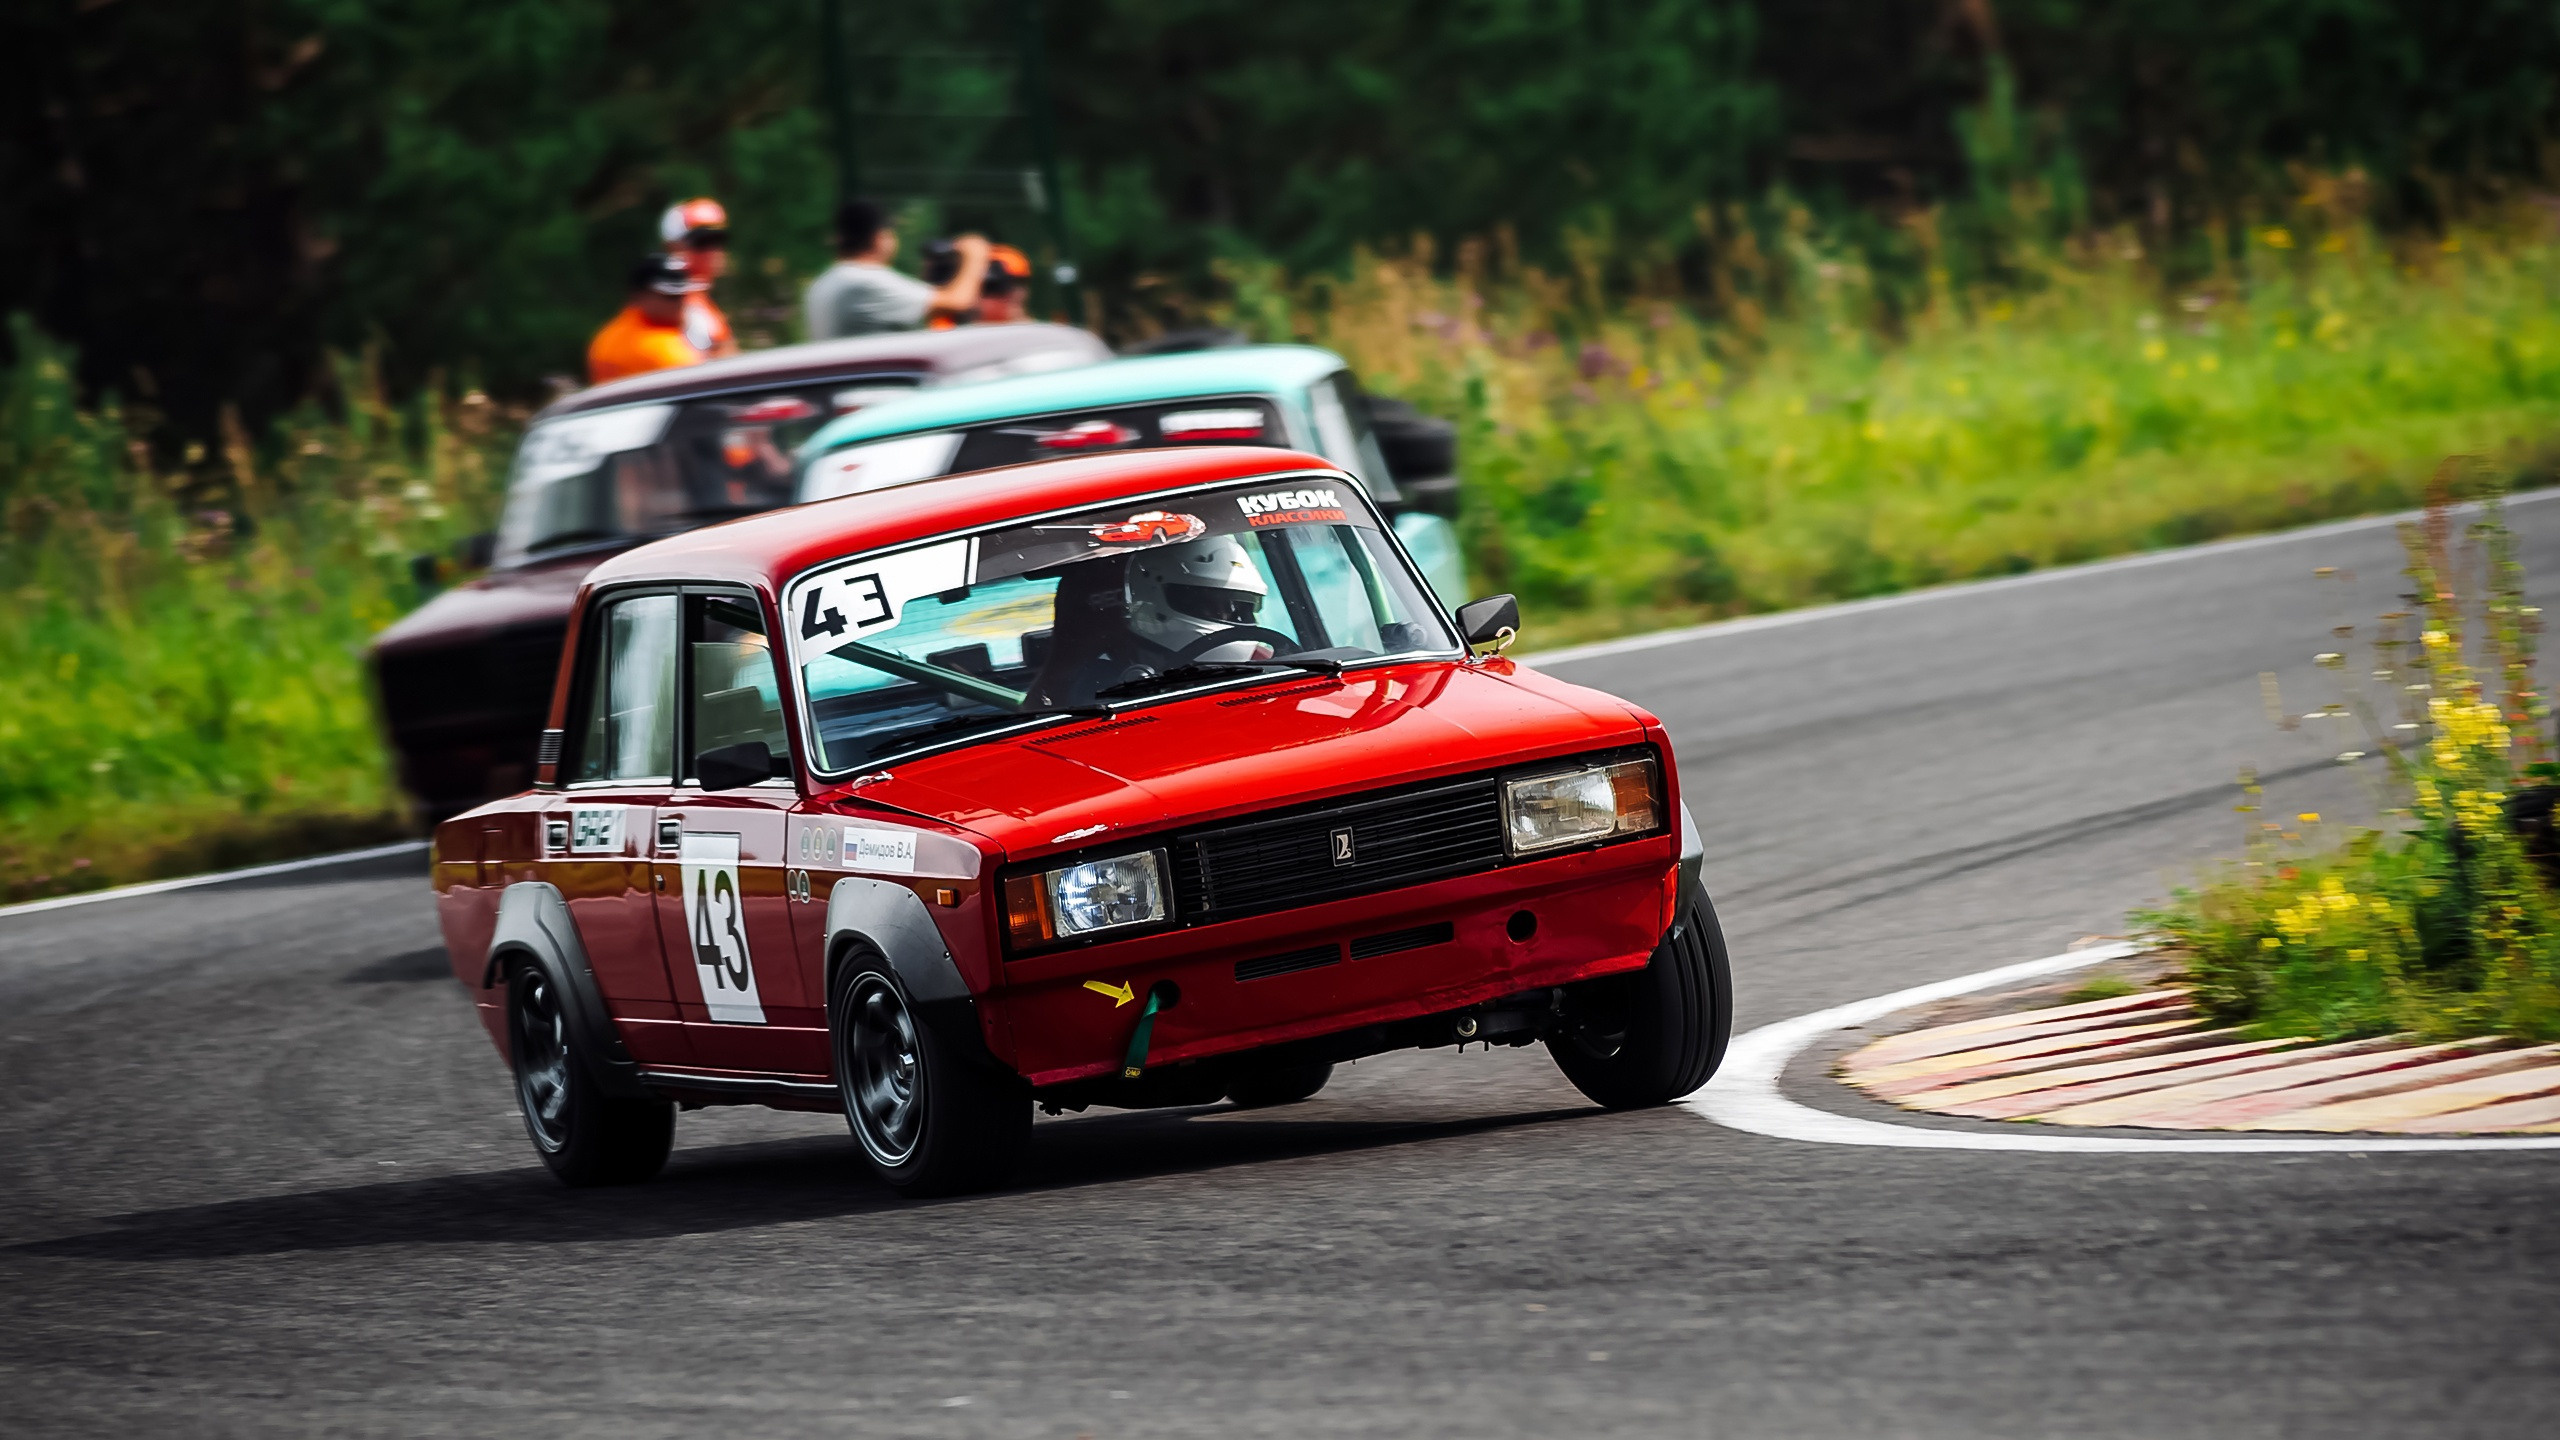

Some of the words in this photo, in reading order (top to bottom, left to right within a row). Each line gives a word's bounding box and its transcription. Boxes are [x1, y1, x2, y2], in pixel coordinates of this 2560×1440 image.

[1237, 490, 1341, 514] КУБОК
[1248, 510, 1347, 527] КЛАССИКИ
[801, 573, 894, 641] 43
[859, 838, 895, 859] Демидов
[696, 869, 749, 992] 43
